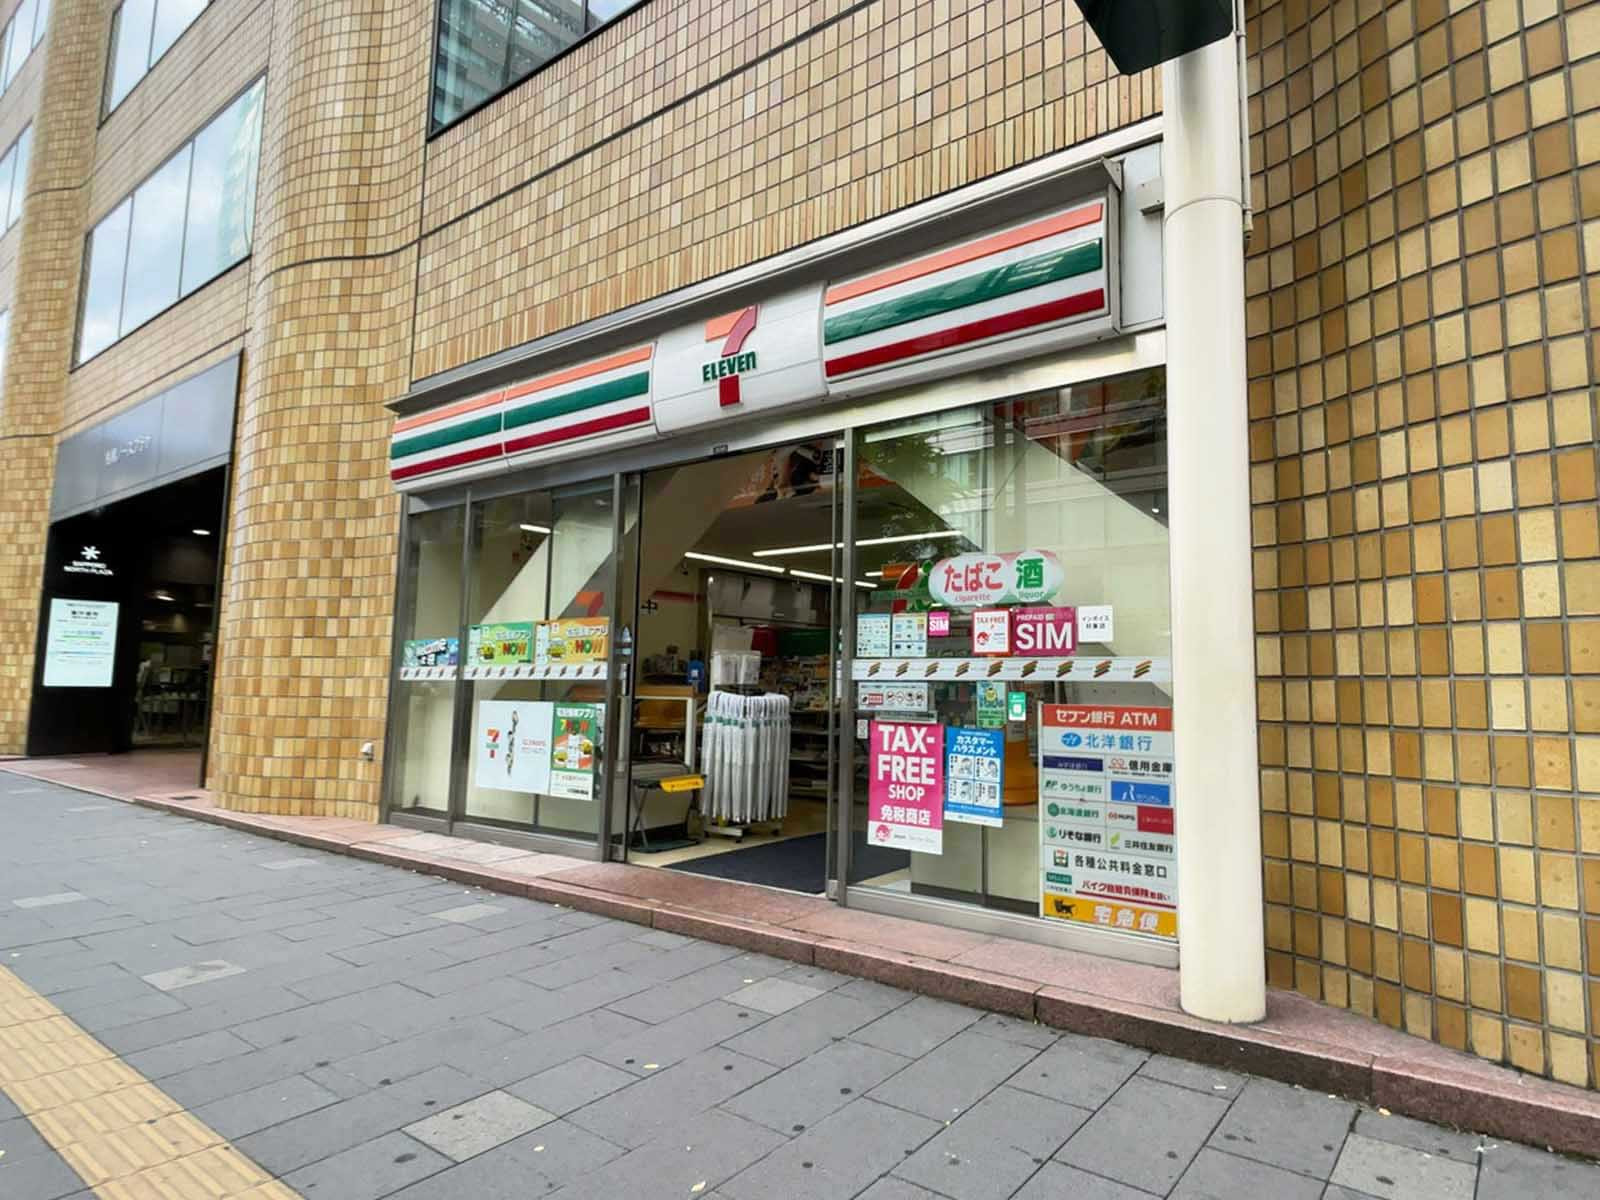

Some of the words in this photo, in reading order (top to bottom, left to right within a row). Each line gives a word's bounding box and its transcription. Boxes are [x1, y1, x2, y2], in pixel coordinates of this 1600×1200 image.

[944, 561, 1003, 592] たばこ
[1016, 558, 1044, 589] 酒
[929, 620, 949, 632] SIM
[1016, 622, 1072, 650] SIM
[1056, 710, 1116, 725] セブン銀行
[1120, 712, 1158, 726] ATM
[878, 725, 935, 754] TAX-
[956, 735, 994, 745] カスタマー
[1085, 733, 1152, 751] 北洋銀行
[877, 754, 936, 785] FREE
[1129, 760, 1173, 773] 信用金庫
[888, 784, 925, 801] SHOP
[1060, 783, 1102, 794] ゆうちょ銀行
[1059, 829, 1102, 844] りそな銀行
[1124, 839, 1173, 854] 三井住友銀行
[1075, 854, 1167, 879] 各種公共料金窓口
